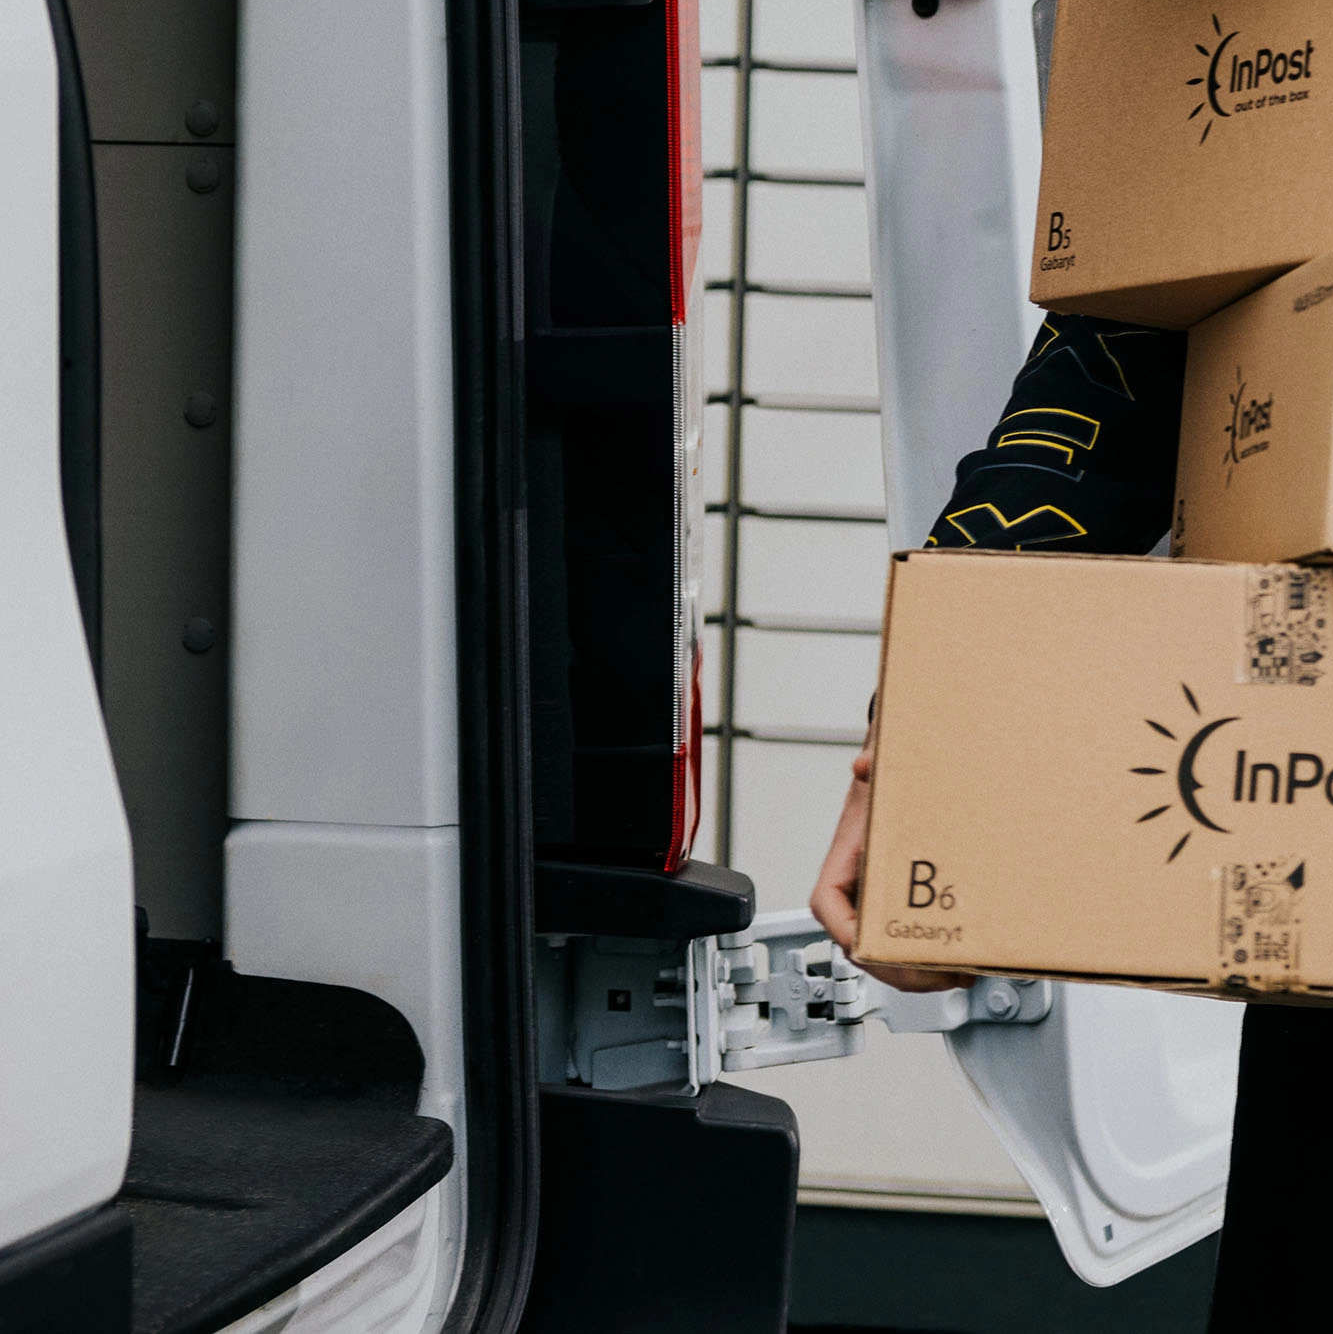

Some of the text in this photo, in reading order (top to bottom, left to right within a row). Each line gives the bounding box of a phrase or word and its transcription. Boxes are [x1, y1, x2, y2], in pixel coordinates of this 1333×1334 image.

[1230, 40, 1314, 93] InPost
[1234, 89, 1310, 113] out of the box
[884, 919, 962, 945] Gabaryt
